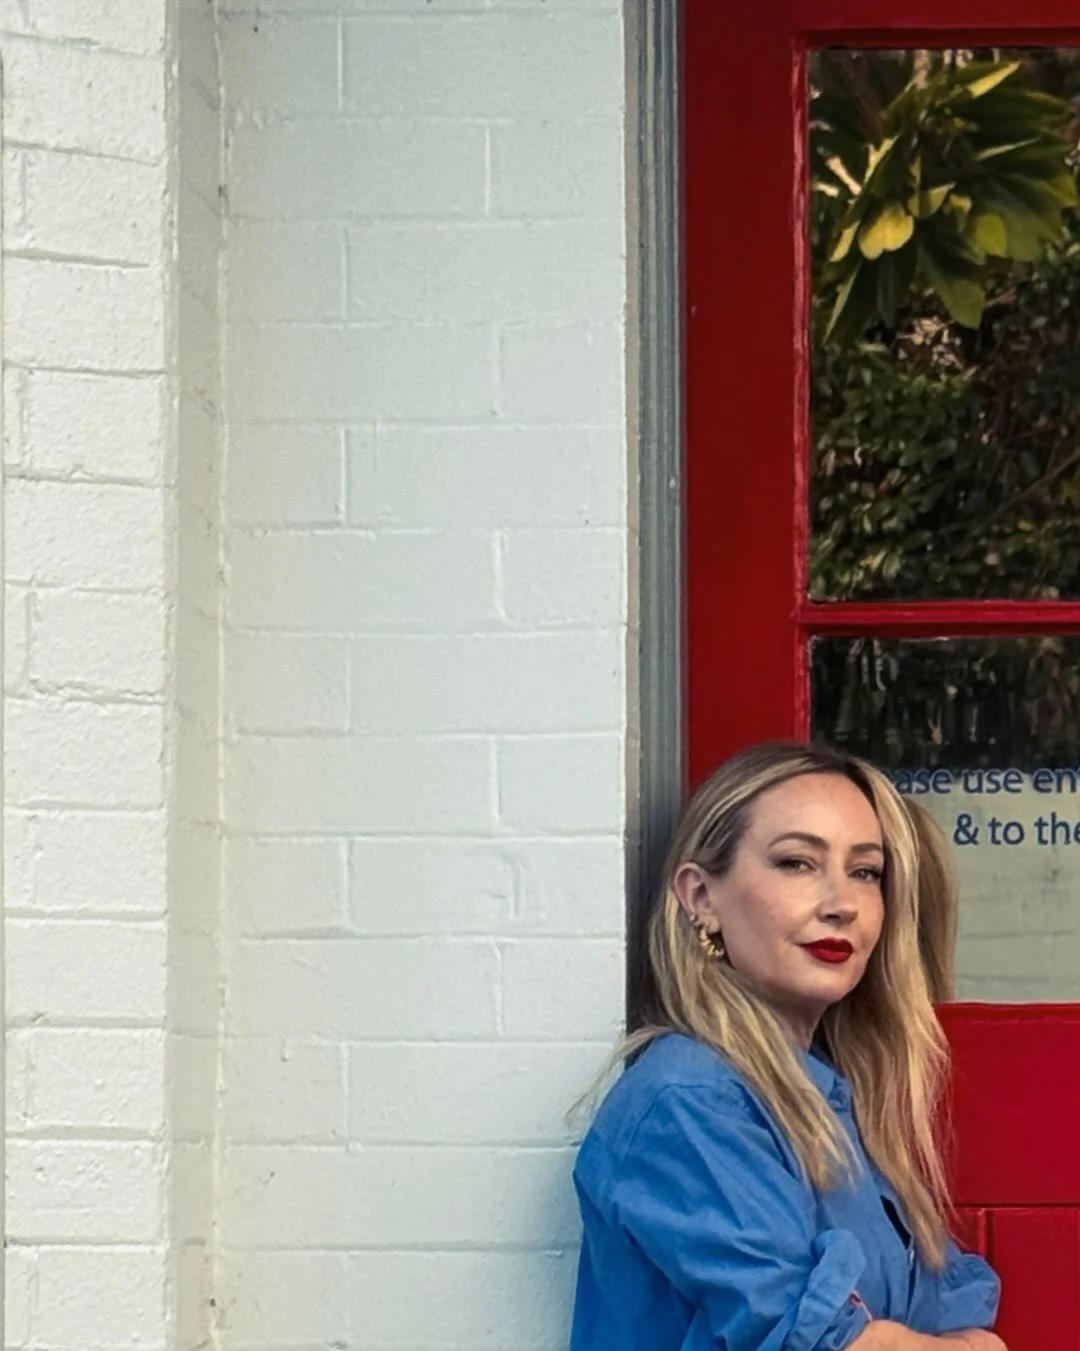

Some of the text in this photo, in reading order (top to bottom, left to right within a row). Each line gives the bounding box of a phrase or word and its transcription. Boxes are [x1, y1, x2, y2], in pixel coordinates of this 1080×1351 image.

[962, 767, 1024, 793] use
[952, 813, 979, 846] &
[987, 815, 1025, 845] to
